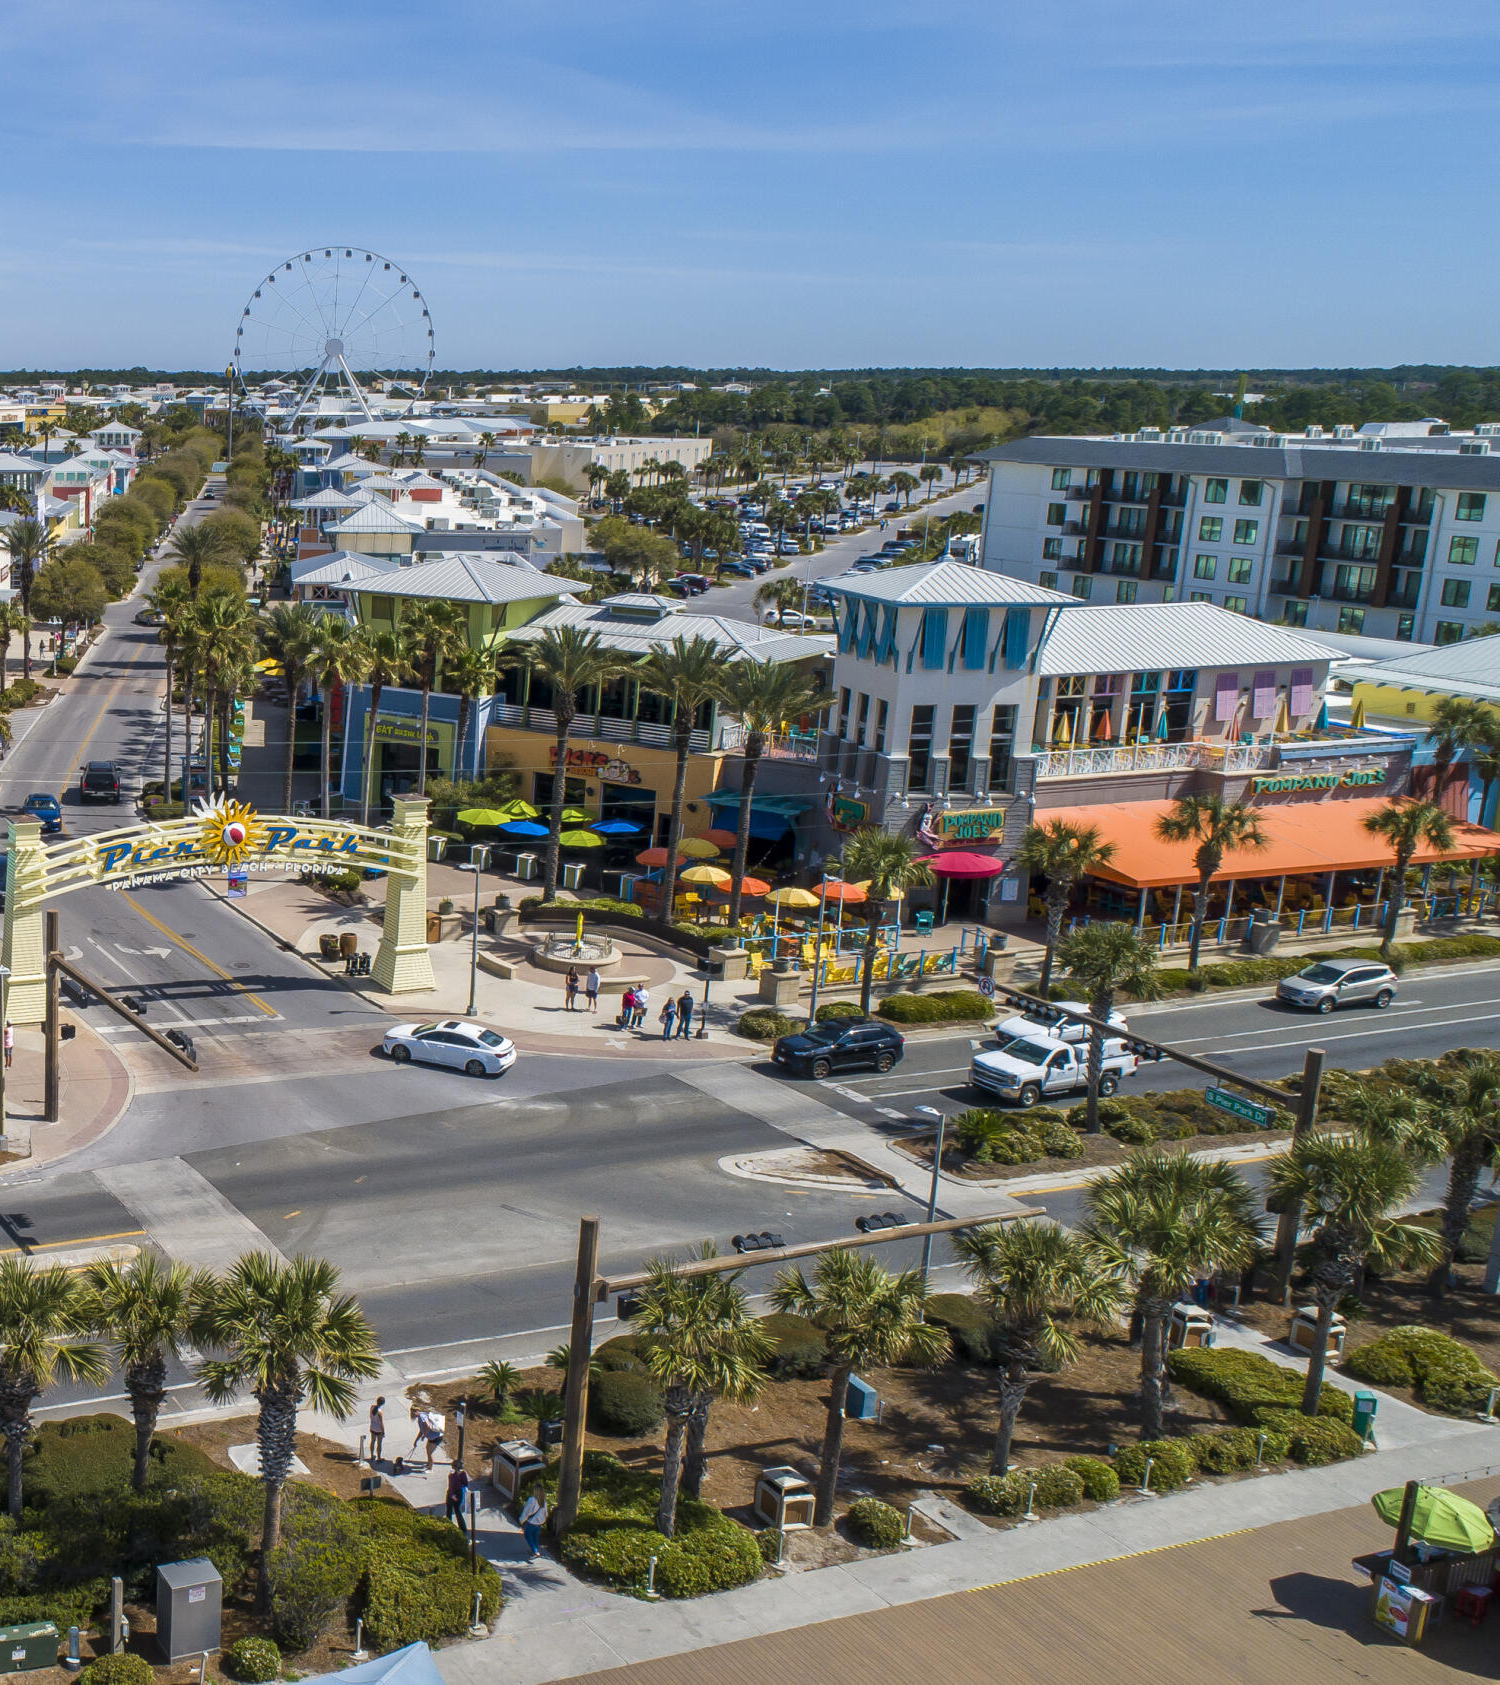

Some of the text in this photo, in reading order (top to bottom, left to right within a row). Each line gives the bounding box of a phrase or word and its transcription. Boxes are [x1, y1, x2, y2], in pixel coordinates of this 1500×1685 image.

[376, 724, 394, 736] EAT
[1252, 775, 1339, 795] POMPANO
[943, 811, 1003, 833] POMPANO
[95, 824, 370, 873] Pier Park
[111, 862, 345, 893] PANAMA CITY BEACH FLORIDA
[1207, 1091, 1267, 1124] S Pier Park Dr
